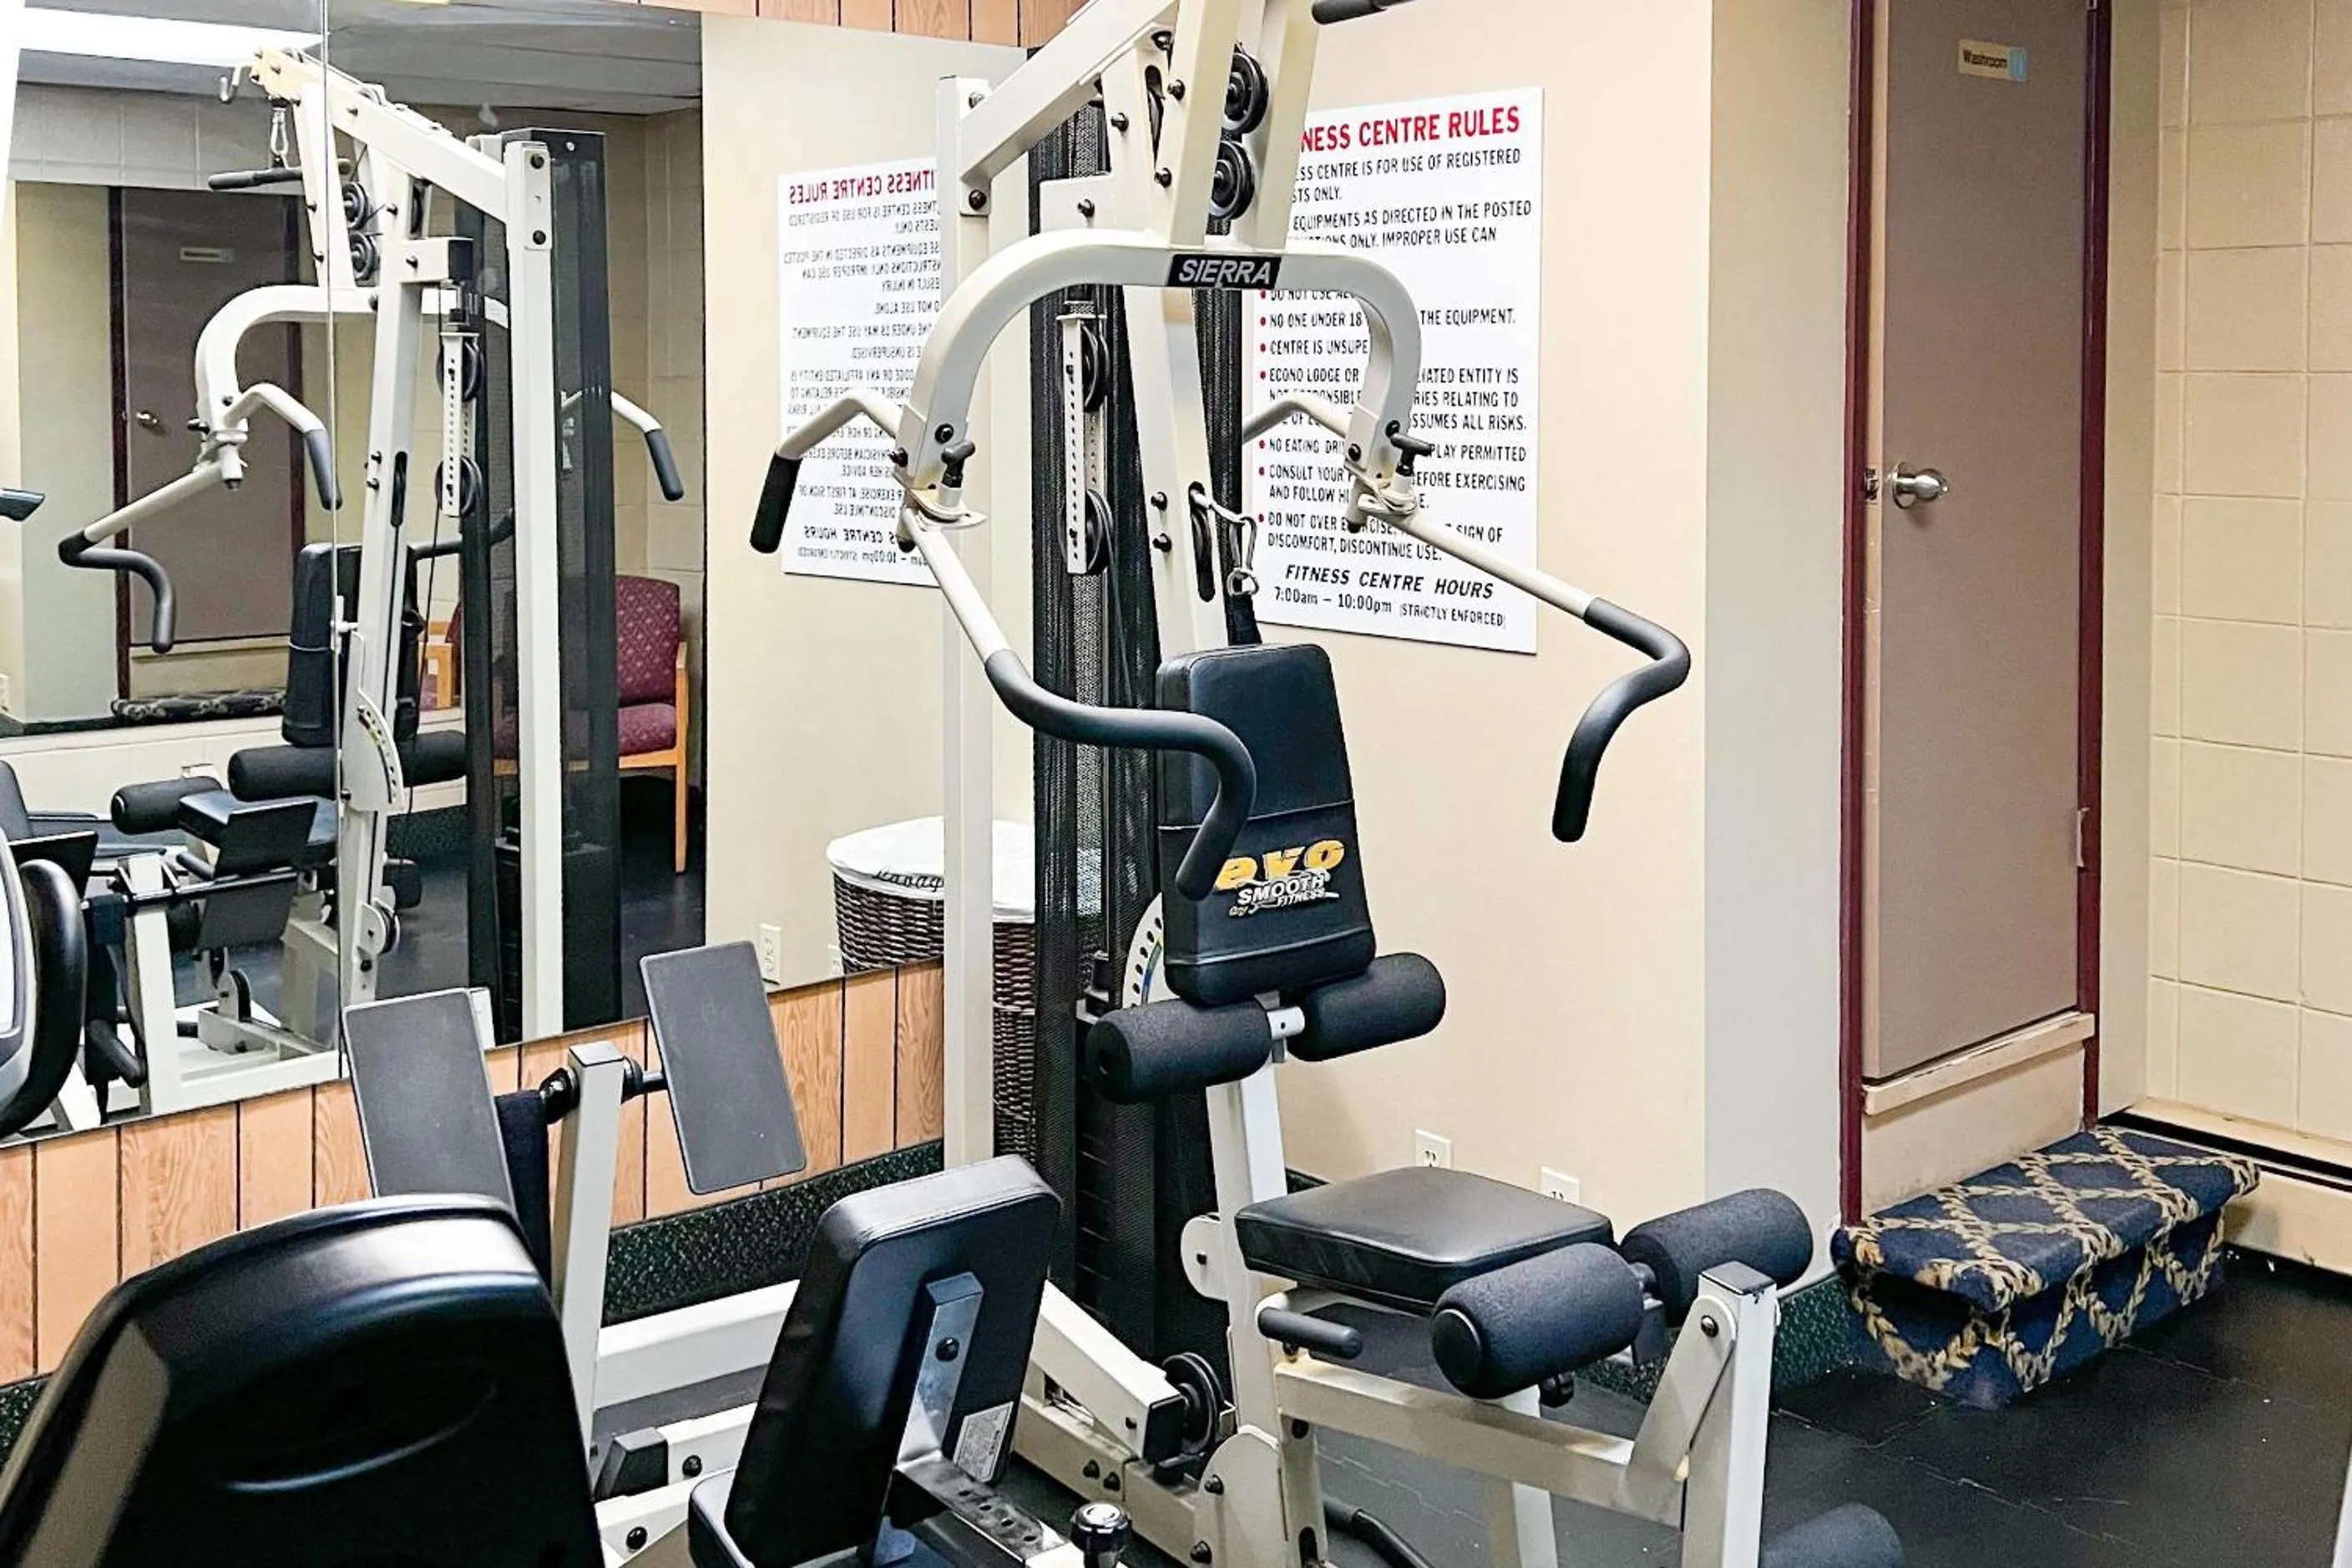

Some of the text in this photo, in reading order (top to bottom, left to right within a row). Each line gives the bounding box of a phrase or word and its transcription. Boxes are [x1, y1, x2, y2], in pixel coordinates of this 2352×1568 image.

[1963, 49, 2007, 68] Washroom
[1301, 106, 1520, 154] NESS CENTRE RULES
[1317, 162, 1358, 180] CENTRE
[1363, 160, 1373, 176] IS
[1377, 158, 1398, 175] FOR
[1403, 156, 1424, 172] USE
[1428, 154, 1441, 170] OF
[1447, 149, 1520, 169] REGISTERED
[1293, 200, 1531, 232] EQUIPMENTS AS DIRECTED IN THE POSTED
[1350, 233, 1379, 249] ONLY.
[1383, 229, 1440, 247] IMPROPER
[1445, 227, 1467, 244] USE
[1471, 226, 1496, 242] CAN
[1178, 258, 1272, 286] SIERRA
[1270, 311, 1363, 328] NO ONE UNDER 18
[1420, 308, 1515, 326] THE EQUIPMENT.
[1270, 339, 1368, 355] CENTRE IS UNSUPE
[1269, 367, 1359, 382] ECONO LODGE OR
[1459, 367, 1502, 384] ENTITY
[1507, 367, 1519, 384] IS
[1443, 391, 1498, 407] RELATING
[1503, 392, 1519, 407] TO
[1412, 413, 1527, 431] SSUMES ALL RISKS.
[1269, 438, 1282, 453] NO
[1460, 444, 1526, 462] PERMITTED
[1269, 464, 1313, 480] CONSULT
[1318, 467, 1344, 482] YOUR
[1412, 472, 1525, 492] EFORE EXERCISING
[1269, 484, 1290, 499] AND
[1293, 485, 1335, 503] FOLLOW
[1268, 512, 1282, 527] DO
[1286, 513, 1305, 529] NOT
[1310, 514, 1337, 531] OVER
[1488, 527, 1503, 543] OF
[1267, 533, 1442, 561] DISCOMFORT, DISCONTINUE USE.
[1285, 564, 1494, 599] FITNESS CENTRE HOURS
[1274, 586, 1318, 604] 7:00am
[1338, 593, 1392, 615] 10:00pm
[1237, 877, 1325, 906] SMOOTH
[1277, 888, 1326, 908] FITNESS
